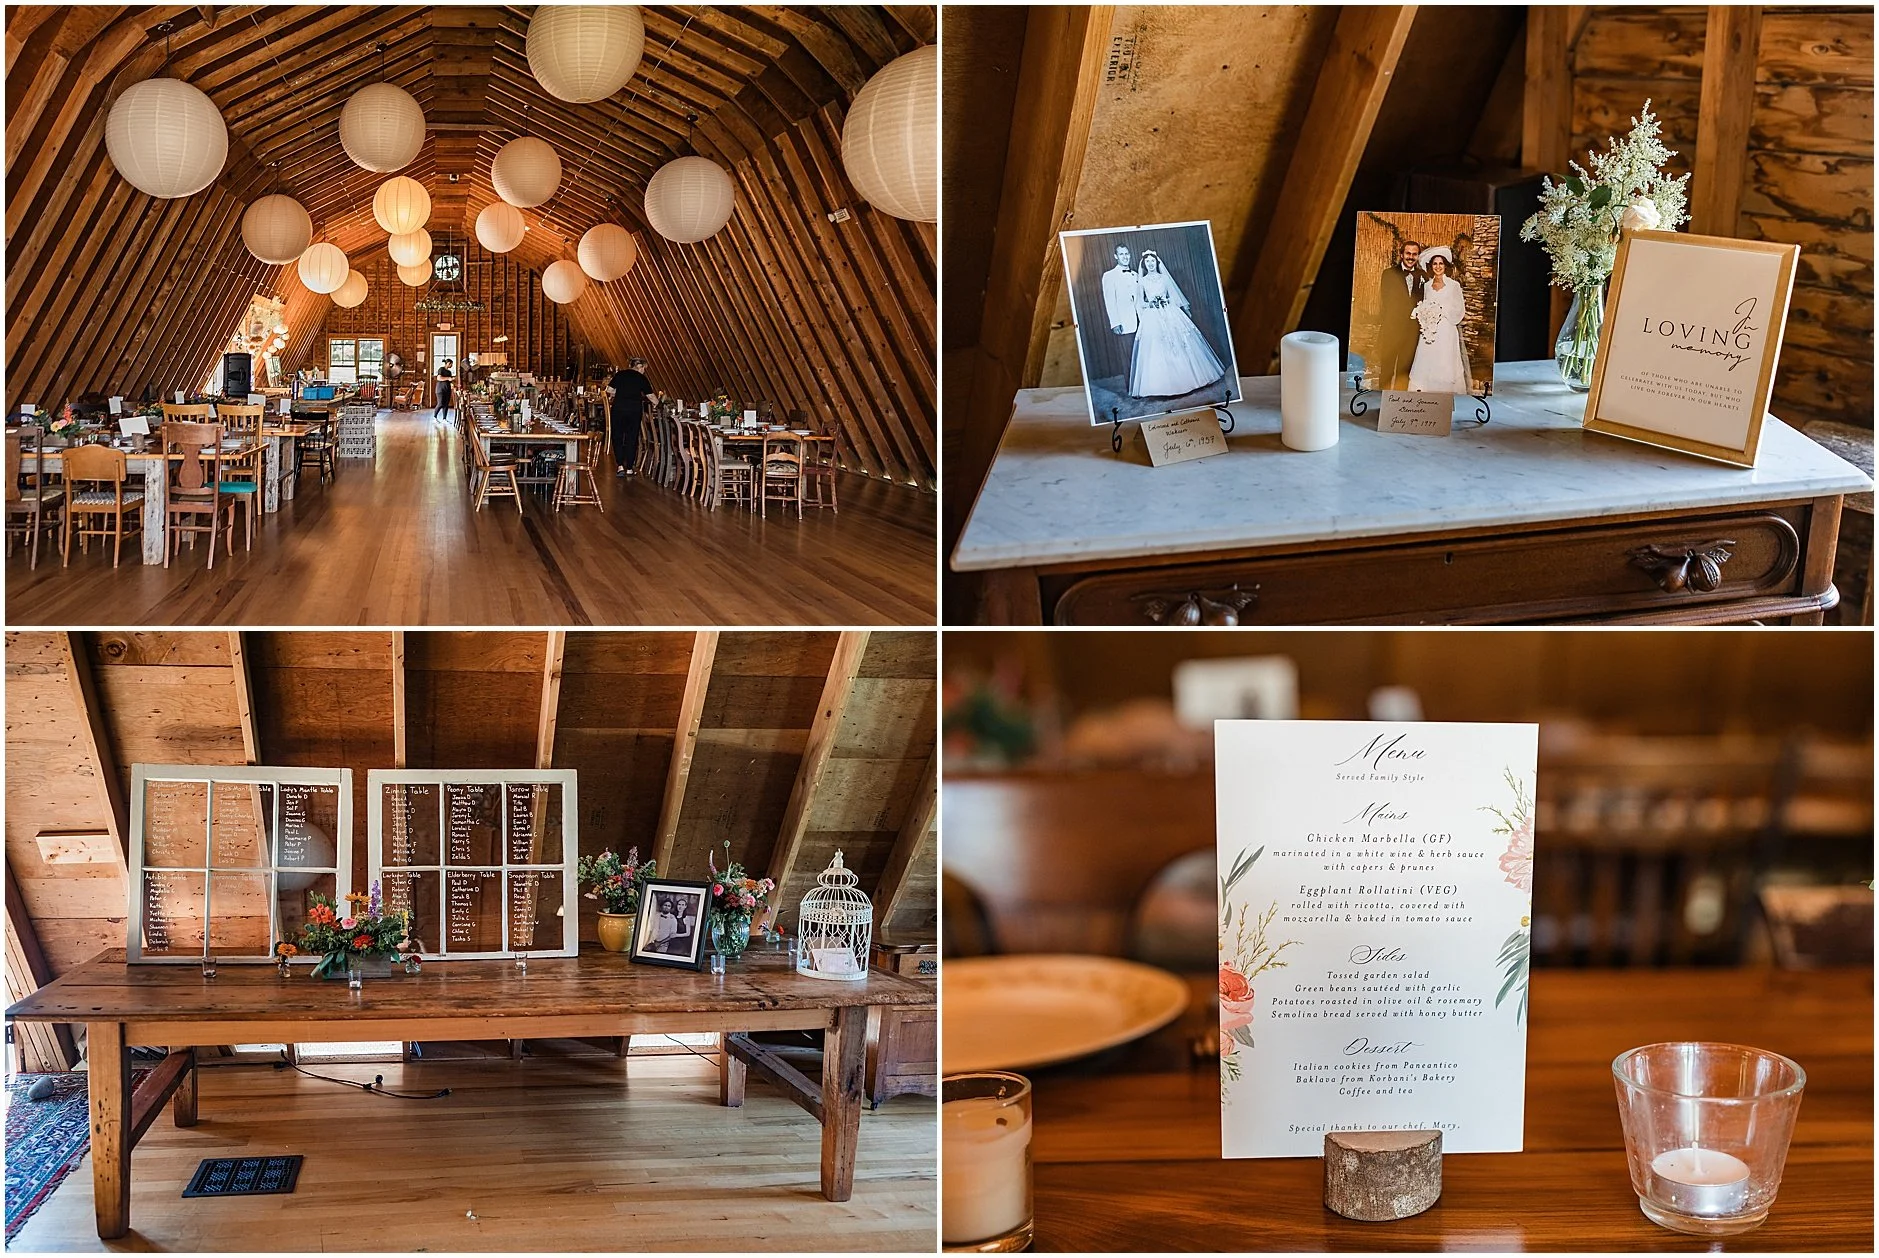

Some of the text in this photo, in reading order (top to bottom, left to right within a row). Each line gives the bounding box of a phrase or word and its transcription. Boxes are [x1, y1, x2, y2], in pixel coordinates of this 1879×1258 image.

[1731, 297, 1759, 335] In
[1643, 317, 1752, 350] LOVING
[1671, 341, 1752, 372] memory
[1620, 375, 1654, 386] CELEBRATE
[1651, 373, 1671, 381] THOSE
[1705, 383, 1731, 393] UNABLE
[1658, 390, 1686, 400] FOREVER
[1714, 402, 1740, 411] HEARTS
[1390, 416, 1406, 428] July
[1163, 441, 1181, 460] July
[1334, 733, 1429, 771] Menu
[1335, 772, 1425, 783] Served Family Style
[409, 786, 429, 795] Table
[446, 785, 484, 795] Peony Table
[1342, 802, 1410, 827] Mains
[1307, 833, 1452, 844] Chicken Marbella (GF)
[1272, 848, 1327, 857] marinated
[1331, 849, 1343, 858] in
[1356, 849, 1385, 857] white
[1389, 850, 1413, 858] wine
[1417, 849, 1425, 858] &
[1430, 849, 1452, 858] herb
[1323, 862, 1435, 873] with capers & prunes
[447, 871, 476, 881] Elderberry
[1299, 885, 1458, 897] Eggplant Rollatini (VEG)
[1291, 900, 1465, 910] rolled with ricotta, covered with
[1283, 914, 1340, 922] mozzarella
[1344, 914, 1352, 922] &
[1357, 914, 1387, 922] baked
[1391, 914, 1401, 923] in
[1405, 915, 1441, 923] tomato
[1348, 944, 1408, 965] Sides
[1327, 970, 1430, 981] Tossed garden salad
[1294, 984, 1324, 992] Green
[1329, 983, 1357, 992] beans
[1404, 983, 1426, 992] with
[1430, 984, 1461, 993] garlic
[1271, 996, 1483, 1007] Potatoes roasted in olive oil & rosemary
[1271, 1008, 1483, 1019] Semolina bread served with honey butter
[1342, 1037, 1425, 1056] Dessert
[1293, 1061, 1458, 1072] Italian cookies from Paneantico
[1296, 1074, 1456, 1085] Baklava from Korbani's Bakery
[1339, 1087, 1371, 1097] Coffee
[1375, 1086, 1394, 1095] and
[1288, 1124, 1326, 1134] Special
[1330, 1123, 1363, 1131] thanks
